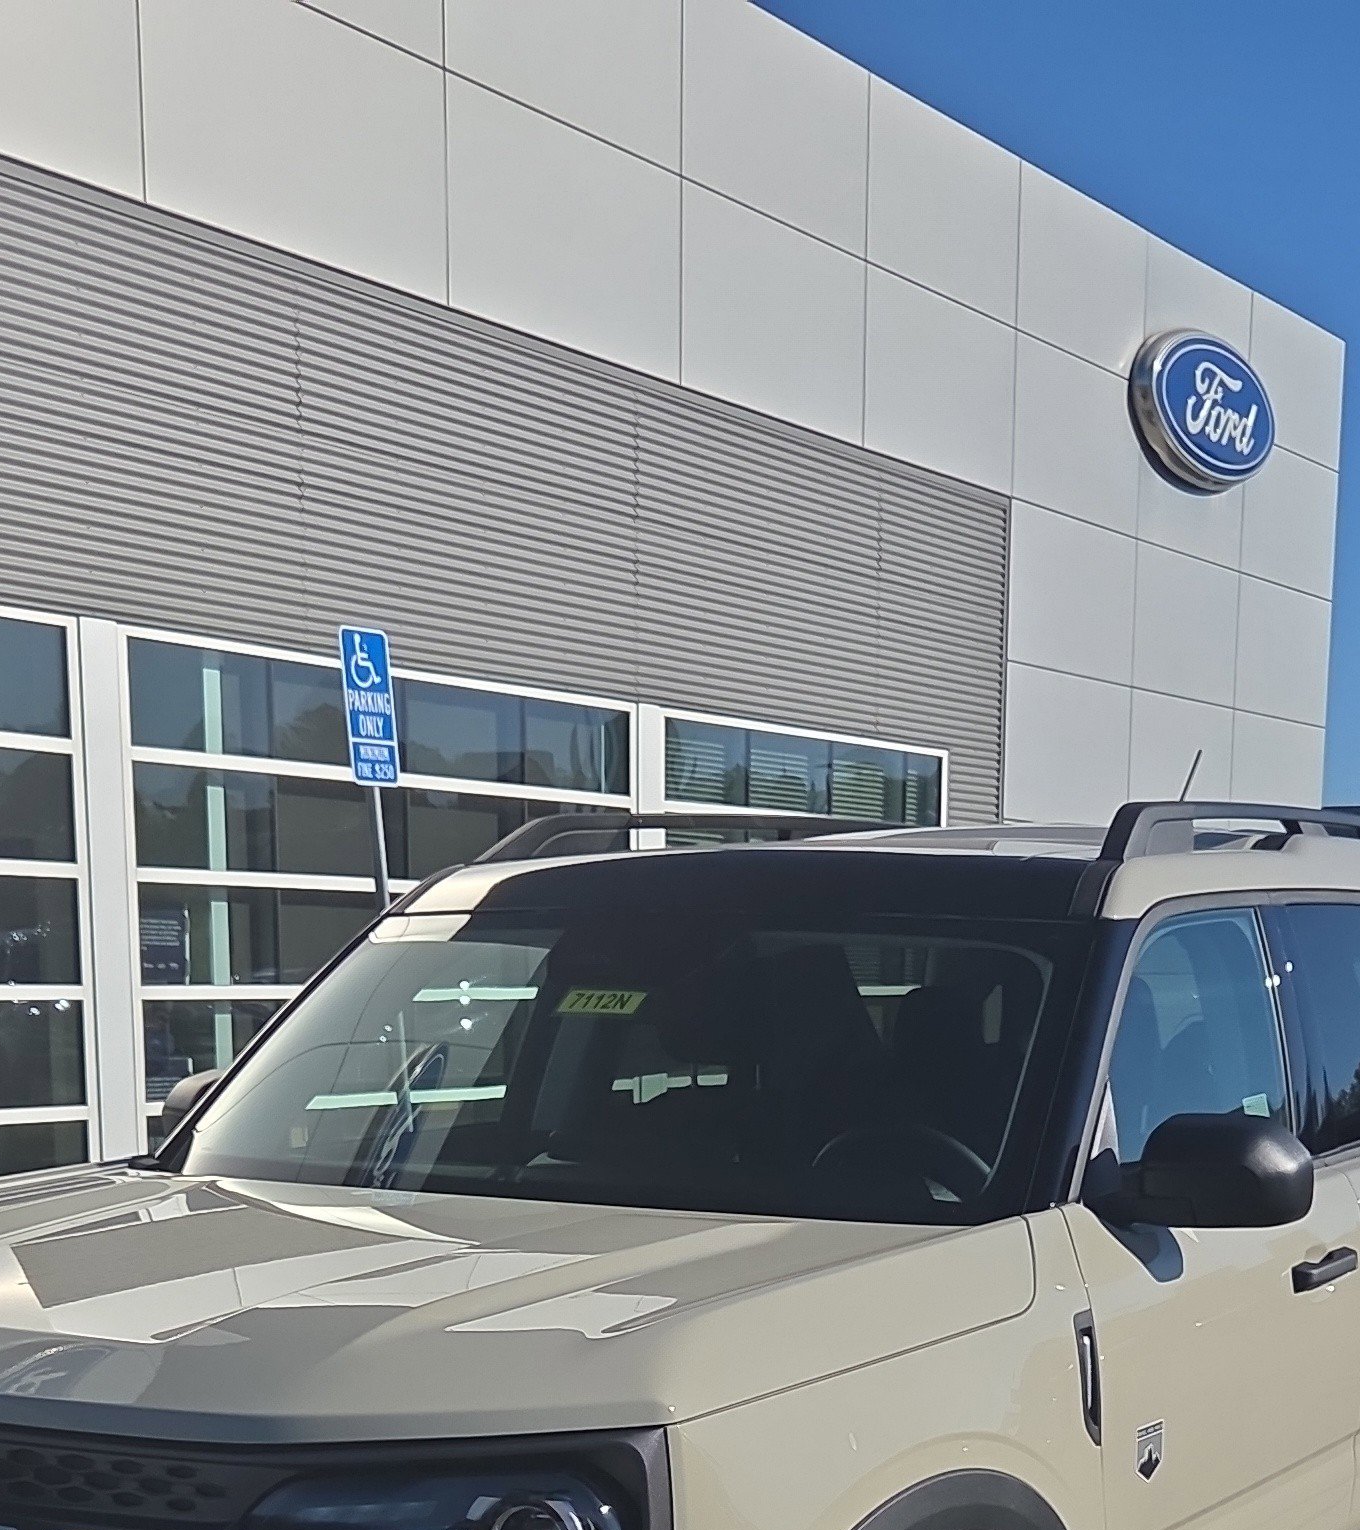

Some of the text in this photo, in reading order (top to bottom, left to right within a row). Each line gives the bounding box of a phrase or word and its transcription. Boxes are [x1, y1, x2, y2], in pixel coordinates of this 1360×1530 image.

[1186, 361, 1258, 455] Ford
[347, 689, 391, 715] PARKING
[358, 714, 384, 738] ONLY
[568, 993, 633, 1010] 7112N
